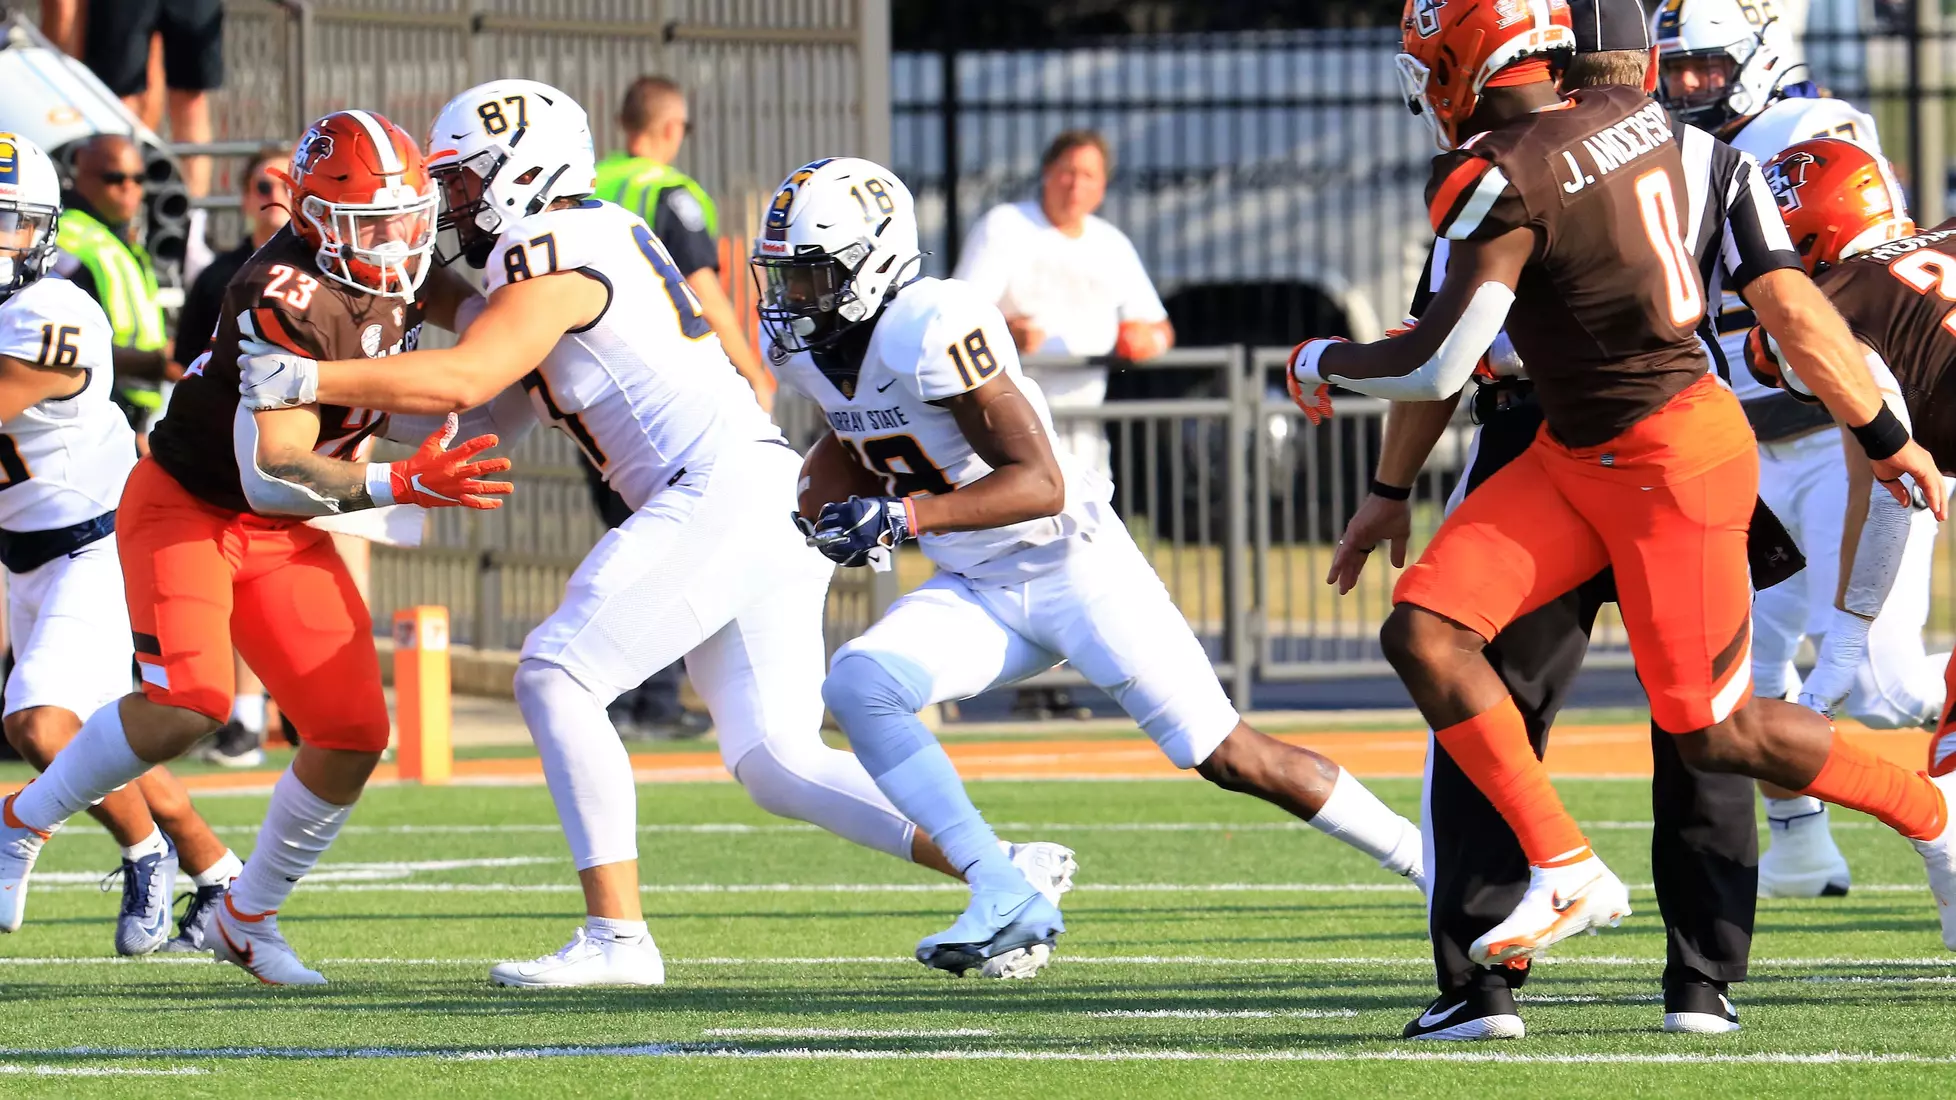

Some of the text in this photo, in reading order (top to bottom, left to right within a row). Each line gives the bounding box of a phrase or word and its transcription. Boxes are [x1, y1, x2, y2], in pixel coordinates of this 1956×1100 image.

[477, 95, 529, 137] 87
[1561, 150, 1596, 194] J.
[851, 178, 894, 223] 18
[503, 232, 558, 284] 87
[1634, 166, 1701, 328] 0
[262, 264, 320, 312] 23
[38, 323, 80, 367] 16
[946, 326, 998, 391] 18
[826, 406, 910, 432] URRAY STATE
